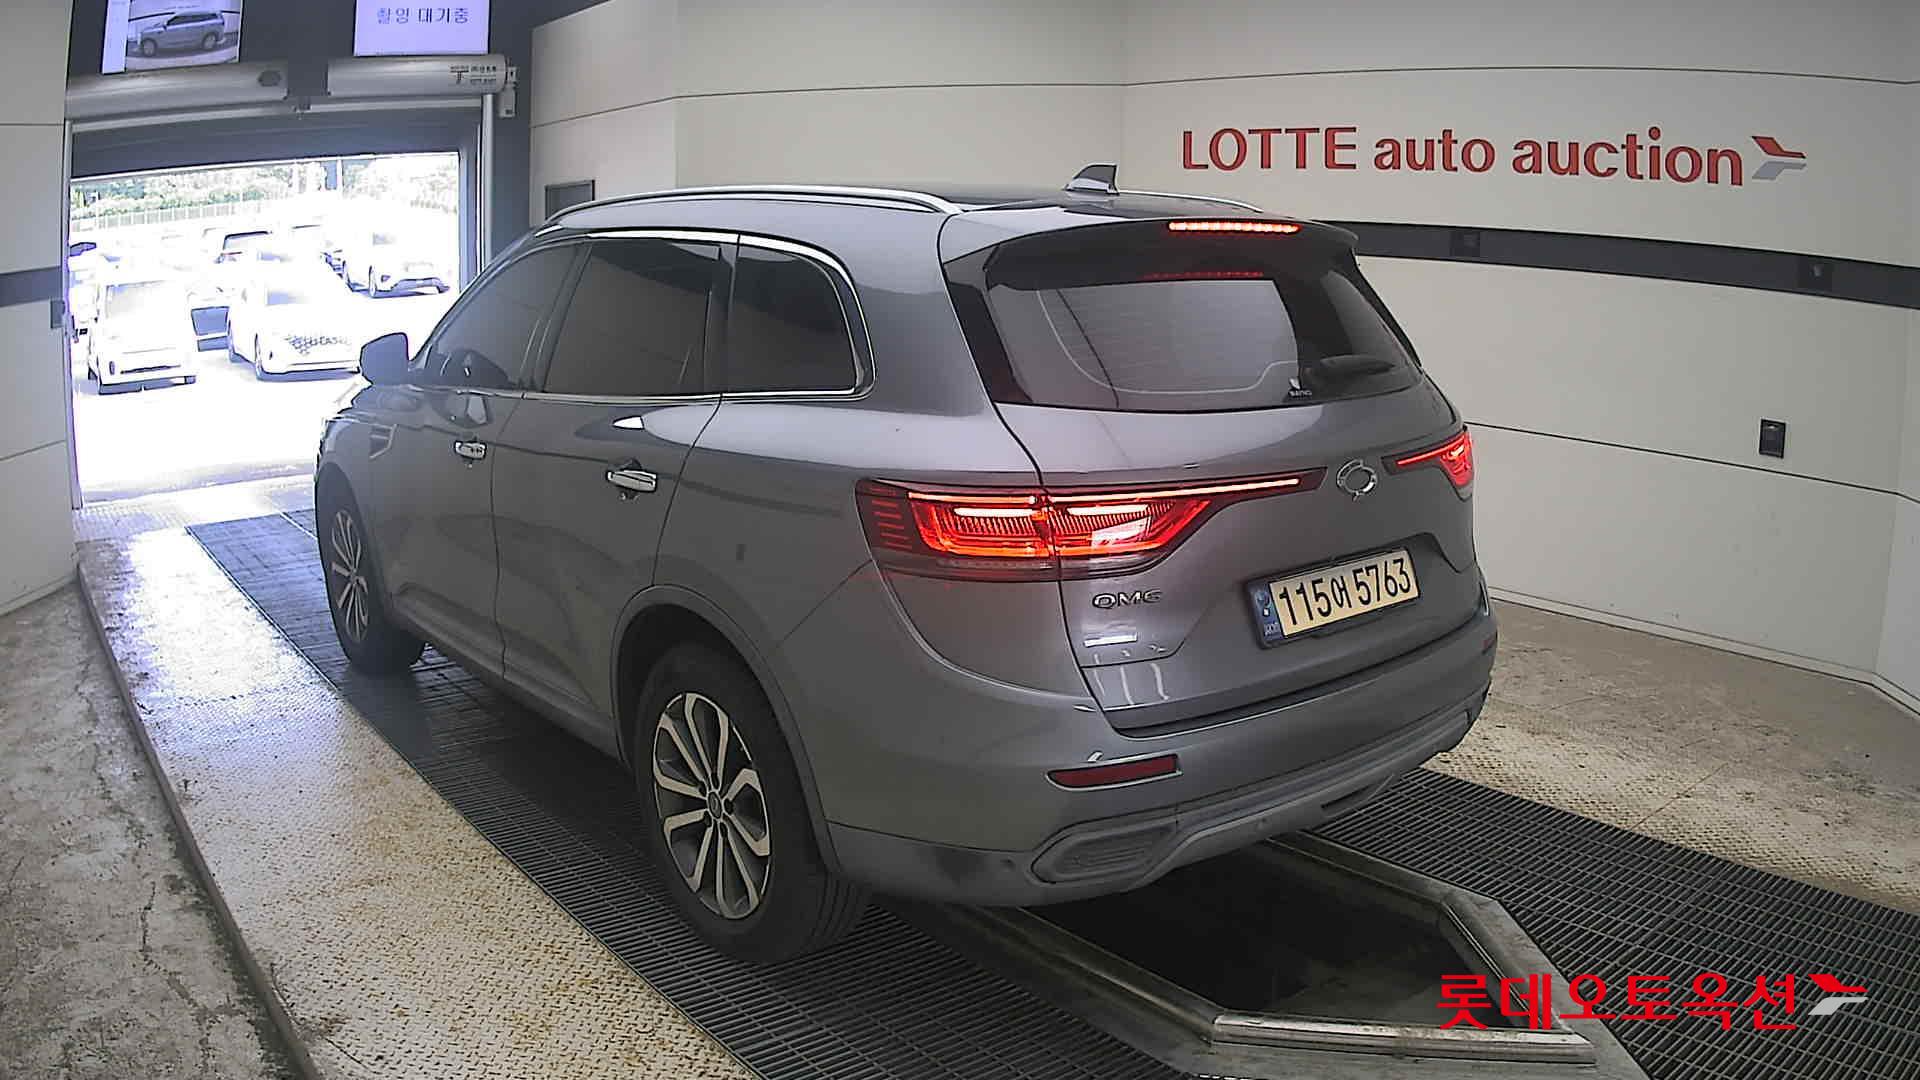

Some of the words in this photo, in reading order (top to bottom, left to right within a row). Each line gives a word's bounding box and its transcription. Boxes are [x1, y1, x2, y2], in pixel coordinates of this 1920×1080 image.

[417, 7, 470, 25] 대기중
[1182, 126, 1358, 171] LOTTE
[1374, 128, 1496, 173] auto
[1511, 126, 1744, 187] auction
